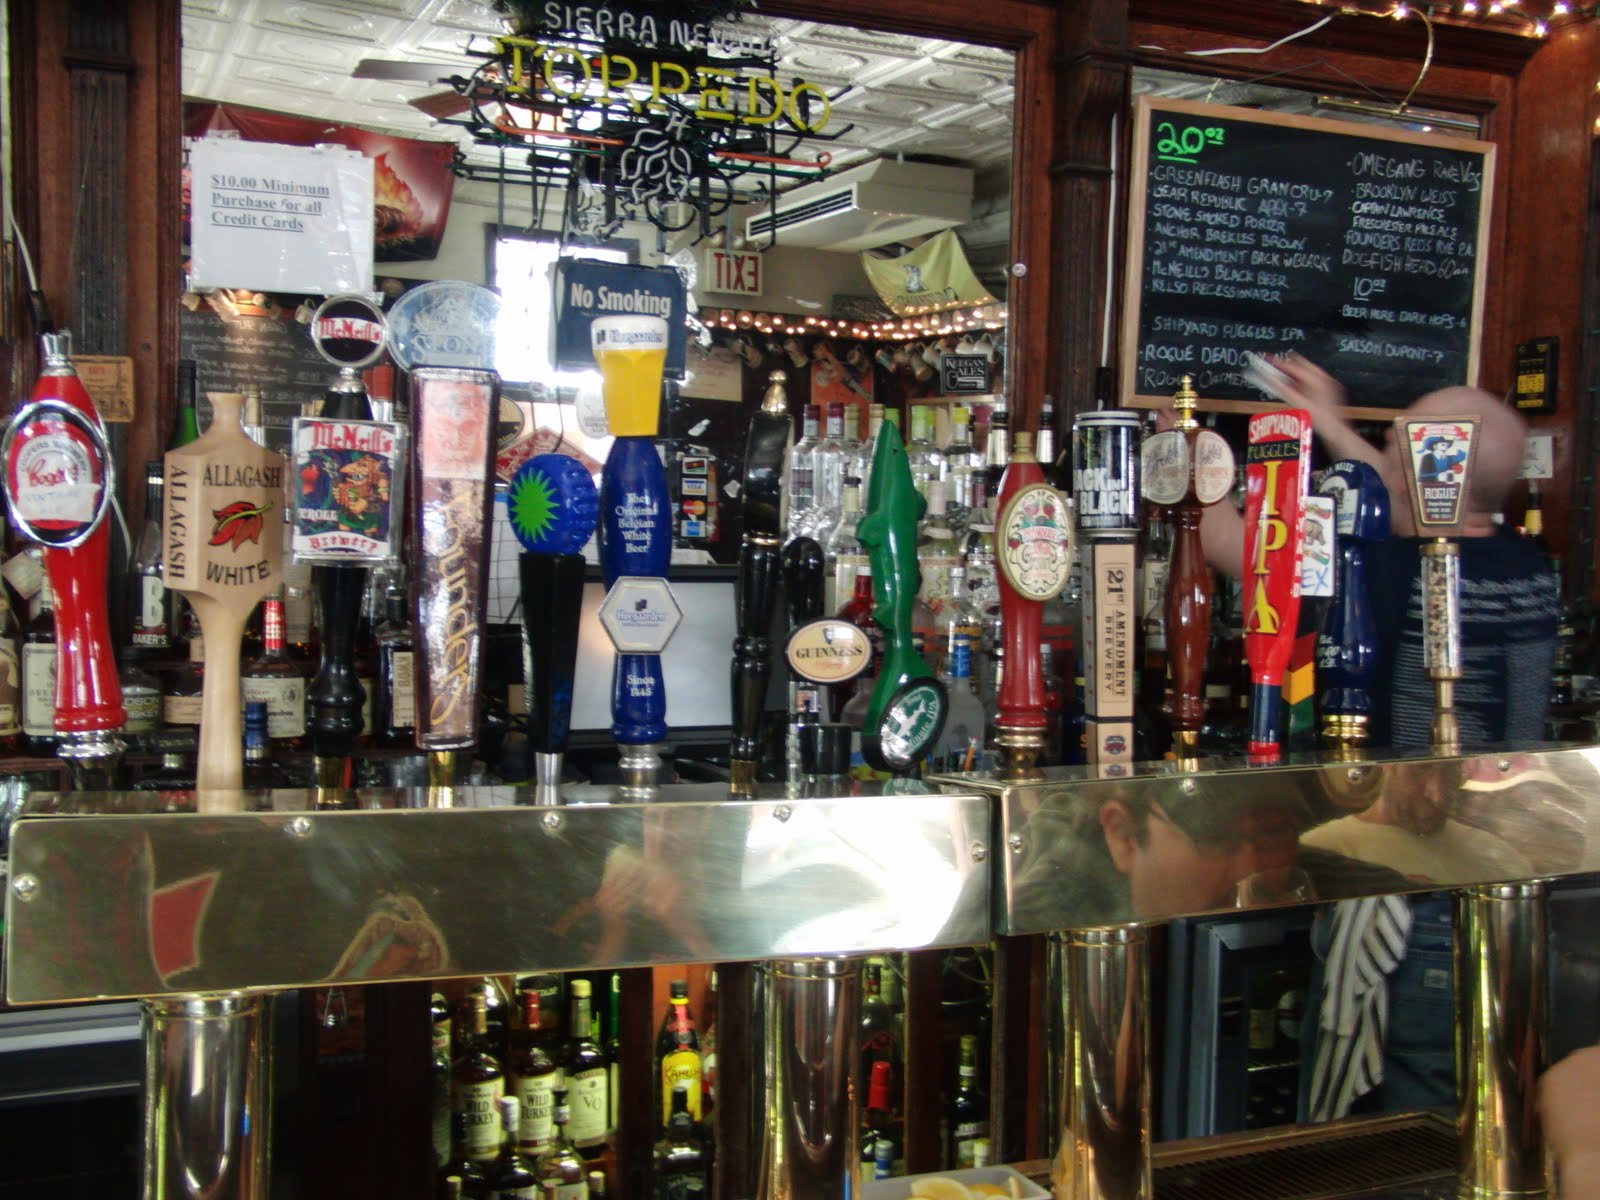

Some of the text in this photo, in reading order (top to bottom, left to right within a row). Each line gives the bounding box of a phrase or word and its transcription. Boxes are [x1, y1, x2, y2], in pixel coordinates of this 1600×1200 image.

[545, 2, 657, 44] SIERRA
[1352, 152, 1426, 179] OMEGANG
[211, 175, 330, 196] $10.00 Minimum
[1356, 182, 1417, 200] BROOKLYN
[212, 192, 321, 213] Purchase for all
[1191, 190, 1247, 211] REPUBLIC
[211, 211, 304, 230] Credit Cards
[1153, 203, 1192, 222] STONE
[1194, 210, 1240, 228] SMOKED
[1390, 204, 1446, 223] LAWRENCE
[1154, 222, 1200, 240] ANCHOR
[1346, 230, 1401, 251] FOUNDERS
[1152, 278, 1189, 293] KELSO
[1214, 264, 1255, 281] BLACK
[1257, 271, 1290, 289] BEER
[571, 283, 671, 318] No Smoking
[320, 317, 382, 341] McNeill's
[1152, 316, 1217, 336] SHIPYARD
[1280, 327, 1306, 341] IPA
[946, 358, 985, 368] KEEGAN
[1145, 344, 1194, 361] ROGUE
[958, 366, 985, 376] ALES
[312, 422, 393, 452] McNeill's
[1250, 414, 1300, 444] SHIPYARD
[1249, 441, 1300, 459] FUGGLES
[203, 464, 281, 488] ALLAGASH
[1080, 490, 1129, 515] BLACK
[1423, 487, 1457, 499] ROGUE
[169, 465, 188, 578] ALLAGASH
[298, 508, 338, 521] TROLL
[309, 535, 378, 551] Brewery
[206, 560, 271, 586] WHITE
[616, 609, 666, 622] Hoegaarden
[133, 633, 167, 643] BAKER'S
[796, 646, 862, 659] GUINNESS
[1105, 616, 1113, 691] BREWERY
[1115, 611, 1126, 697] AMENDMENT
[527, 1094, 549, 1106] WILD
